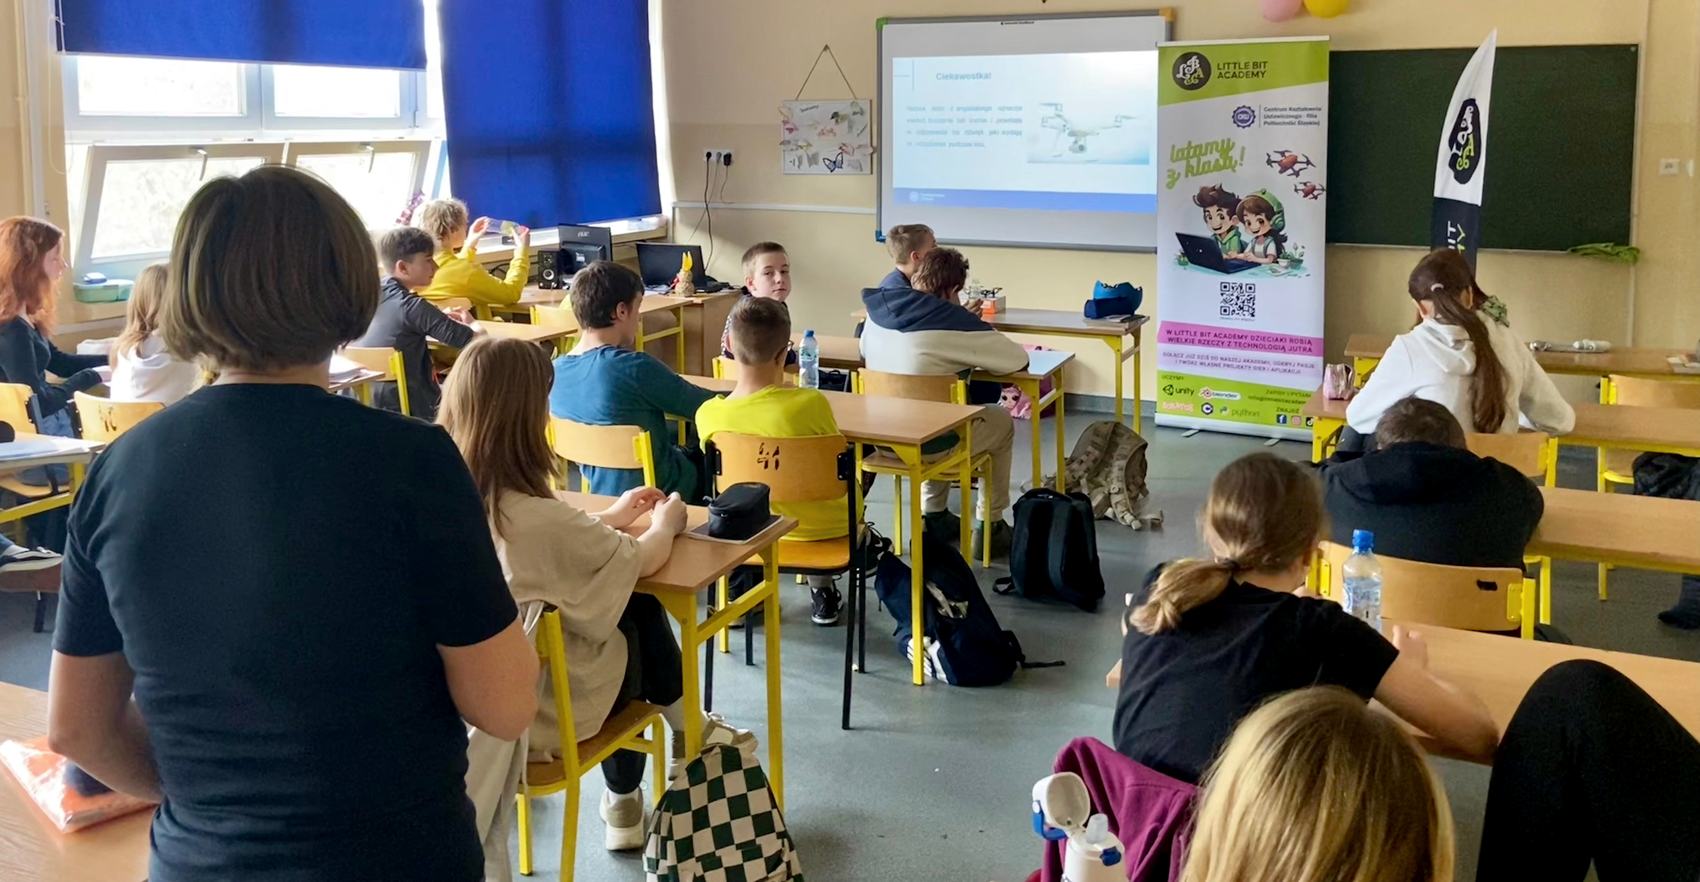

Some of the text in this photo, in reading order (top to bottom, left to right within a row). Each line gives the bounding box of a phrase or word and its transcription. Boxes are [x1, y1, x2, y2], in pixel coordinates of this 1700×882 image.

[1217, 61, 1268, 70] LITTLE BIT
[1217, 70, 1267, 80] ACADEMY
[1166, 169, 1180, 189] z
[1198, 338, 1225, 346] RZECZY
[1234, 342, 1286, 352] TECHNOLOGIĄ
[1214, 332, 1248, 340] ACADEMY
[1290, 338, 1312, 346] ROBIĄ
[1175, 388, 1194, 396] unity
